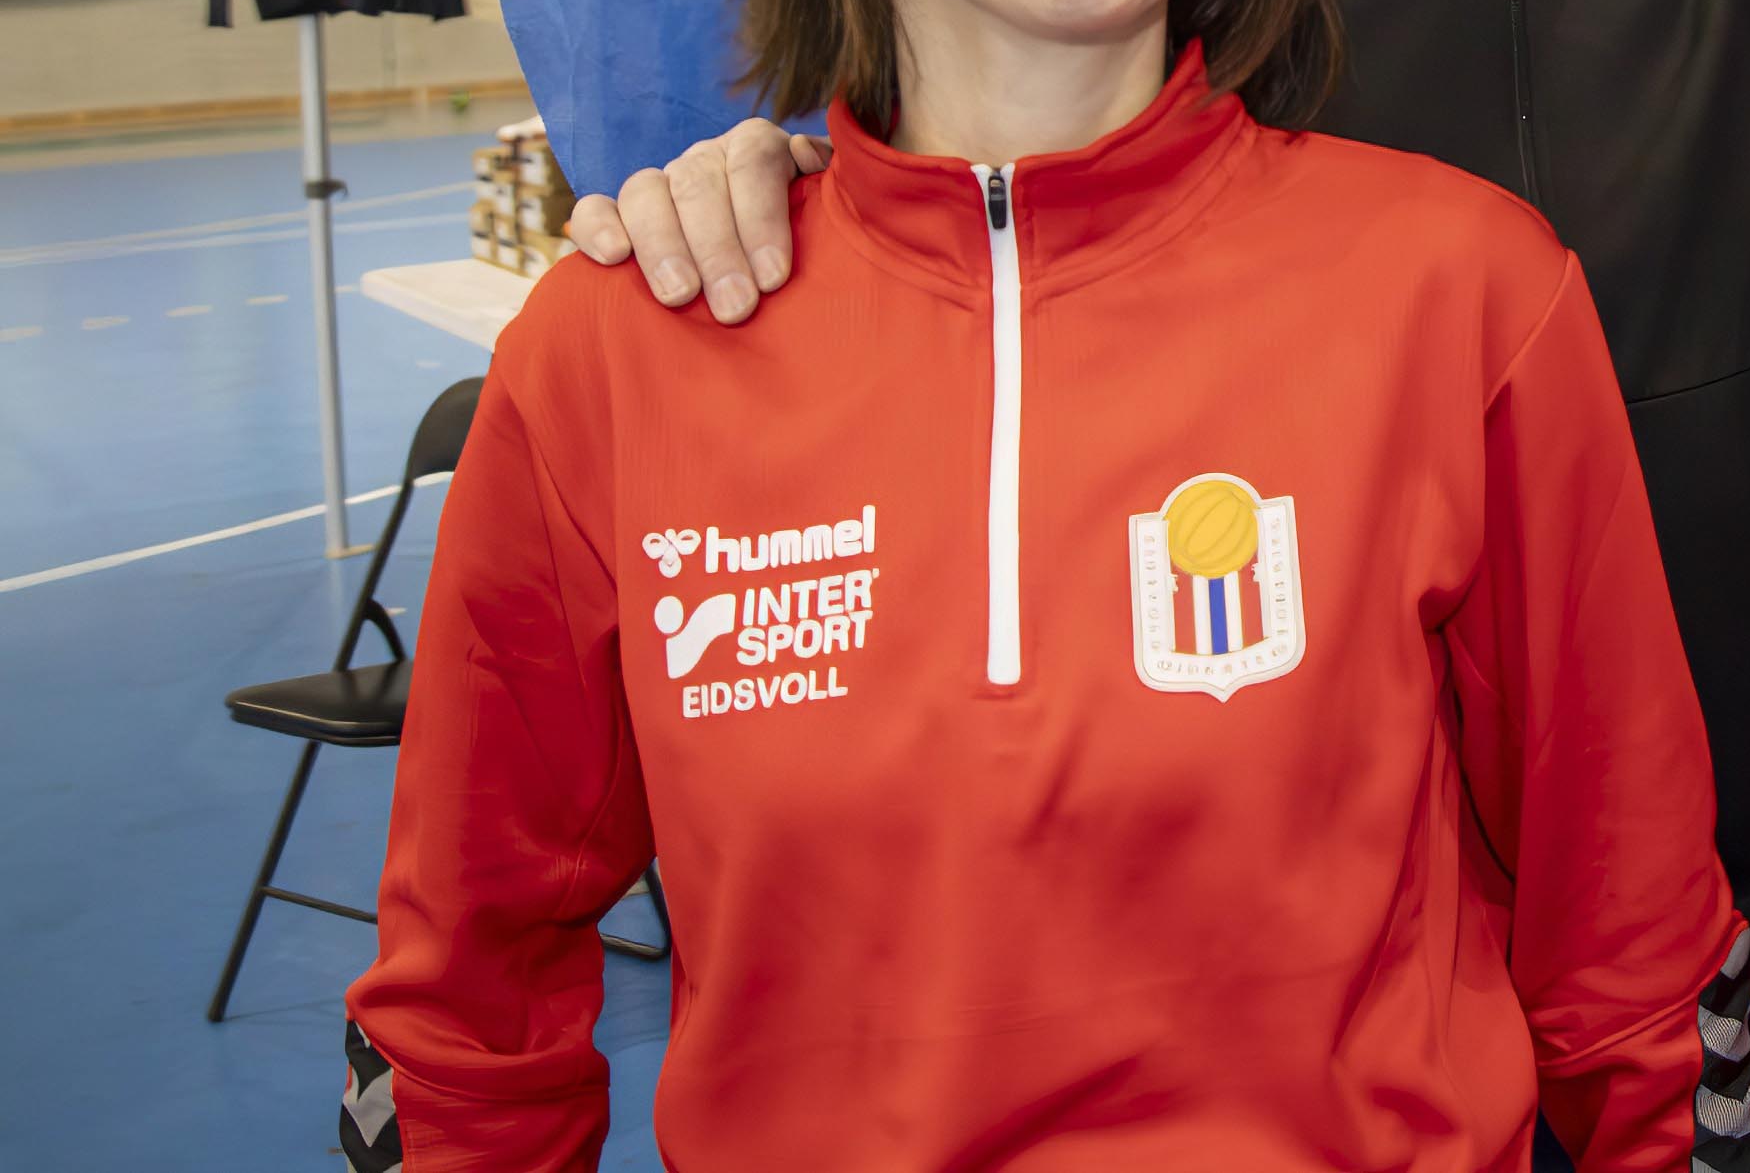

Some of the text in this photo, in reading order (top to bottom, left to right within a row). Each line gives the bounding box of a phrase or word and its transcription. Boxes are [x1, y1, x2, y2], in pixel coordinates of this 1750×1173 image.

[705, 504, 876, 574] hummel
[742, 569, 873, 627] INTER
[736, 610, 874, 666] SPORT
[682, 667, 849, 719] EIDSVOLL
